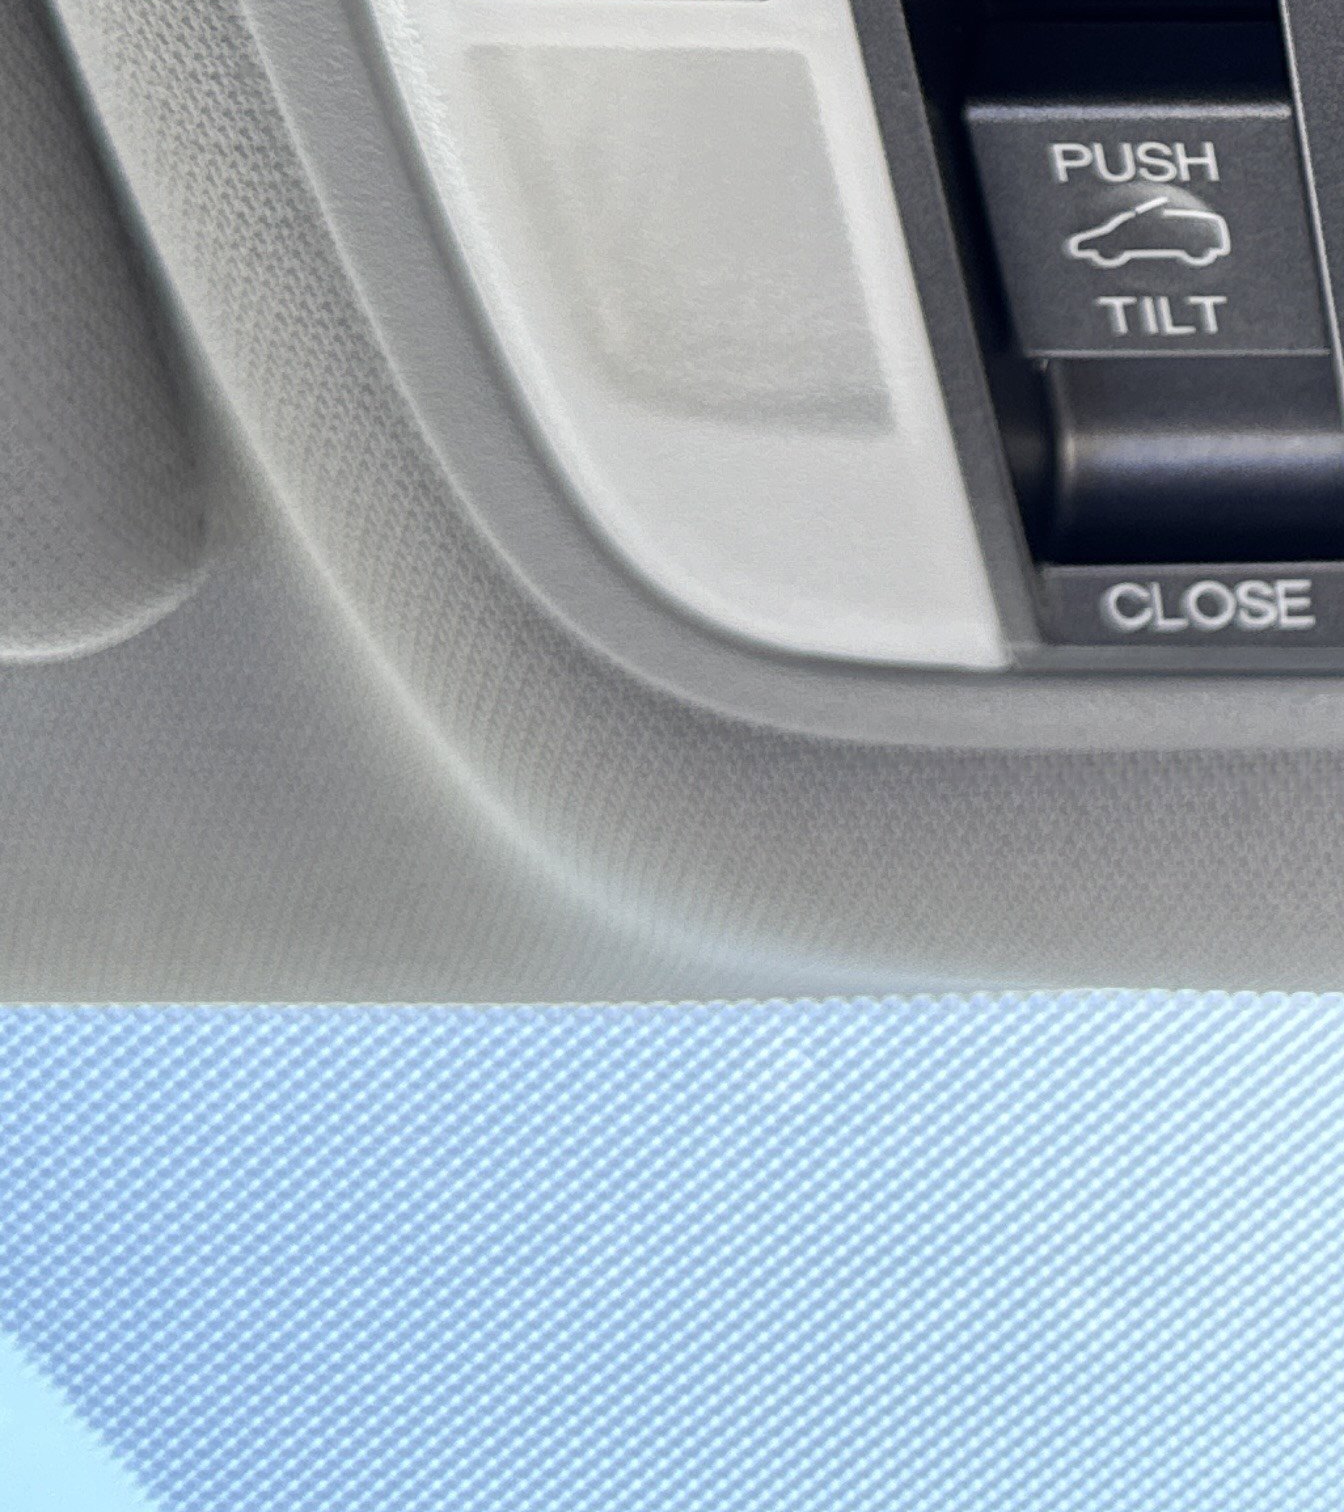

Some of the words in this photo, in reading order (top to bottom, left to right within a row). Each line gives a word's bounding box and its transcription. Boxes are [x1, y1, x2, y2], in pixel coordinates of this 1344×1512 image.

[1051, 142, 1219, 183] PUSH
[1097, 296, 1226, 335] TILT
[1104, 579, 1315, 630] CLOSE
